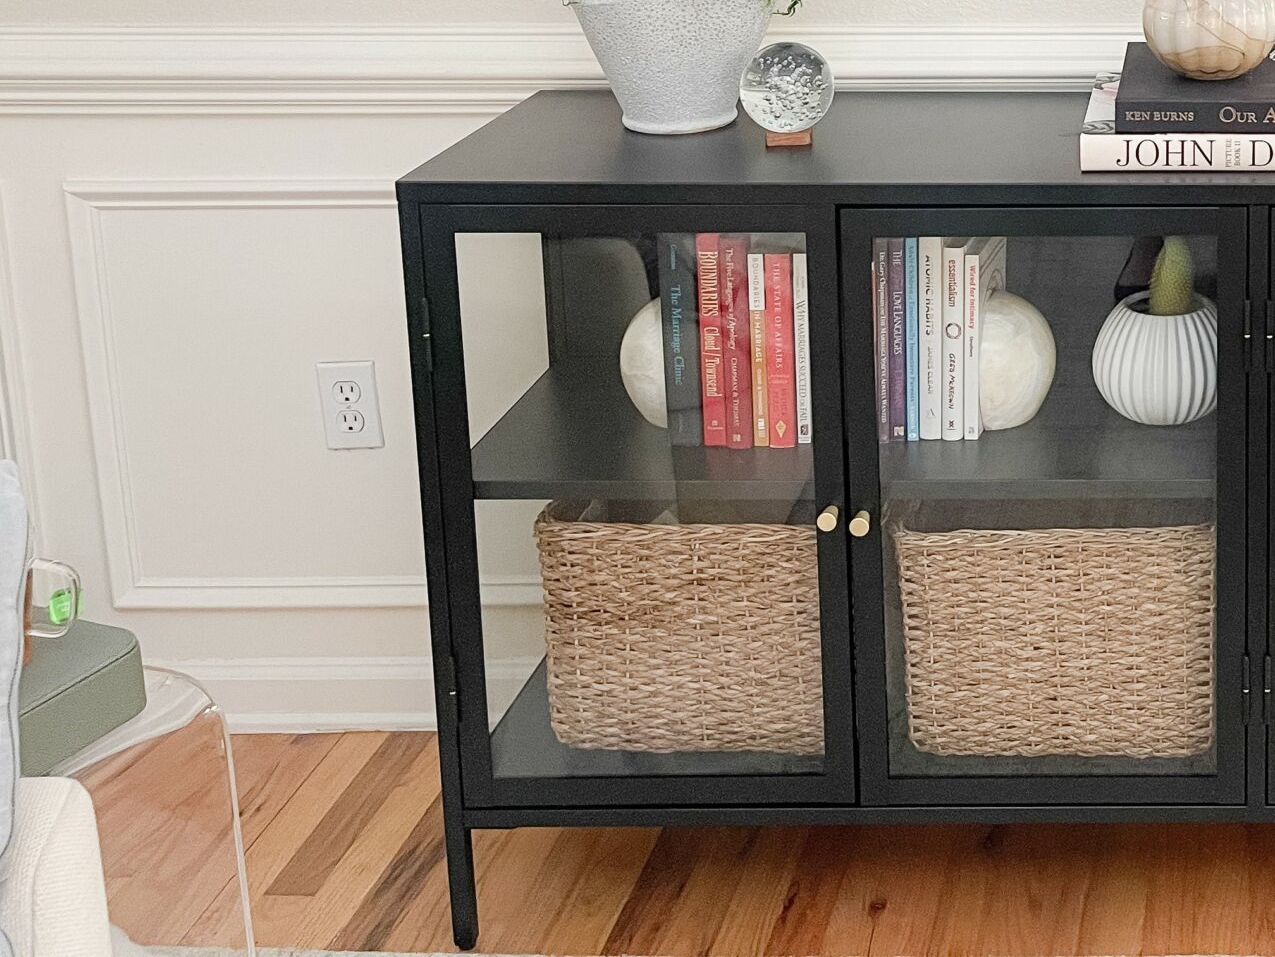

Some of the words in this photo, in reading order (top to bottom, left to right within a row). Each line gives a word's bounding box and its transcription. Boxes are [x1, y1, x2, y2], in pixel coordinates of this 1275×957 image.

[1125, 111, 1151, 121] KEN
[1153, 111, 1194, 121] BURNS
[1219, 106, 1257, 123] OUR
[1116, 139, 1216, 166] JOHN
[1225, 138, 1233, 167] PICTURE
[725, 248, 734, 261] The
[892, 250, 903, 265] THE
[726, 262, 735, 276] Five
[773, 263, 781, 282] THE
[878, 262, 886, 276] Gary
[908, 265, 916, 292] Children
[925, 255, 934, 296] ATOMIC
[969, 265, 977, 286] Wired
[671, 285, 681, 305] The
[698, 251, 719, 316] BOUNDARIES
[725, 277, 735, 312] Languages
[752, 257, 762, 309] BOUNDARIES
[878, 277, 887, 307] Chapman
[948, 259, 957, 307] essentialism
[969, 287, 977, 298] for
[773, 284, 781, 312] STATE
[796, 300, 807, 321] WHY
[893, 291, 904, 311] LOVE
[726, 313, 736, 321] of
[753, 311, 761, 320] IN
[774, 315, 782, 328] OF
[908, 301, 917, 341] Emotionally
[925, 298, 935, 337] HABITS
[967, 299, 977, 330] Intimacy
[671, 308, 683, 353] Marriage
[727, 320, 737, 350] Apology
[754, 321, 763, 363] MARRIAGE
[797, 323, 808, 364] MARRIAGES
[893, 311, 904, 355] LANGUAGES
[775, 332, 783, 369] AFFAIRS
[909, 342, 917, 374] Immature
[926, 346, 934, 370] JAMES
[948, 353, 956, 373] GREG
[674, 356, 685, 385] Clinic
[730, 357, 738, 391] CHAPMAN
[798, 365, 808, 398] SUCCEED
[926, 371, 934, 394] CLEAR
[909, 376, 917, 403] Parents
[800, 408, 808, 422] FAIL
[881, 399, 889, 423] WANTED
